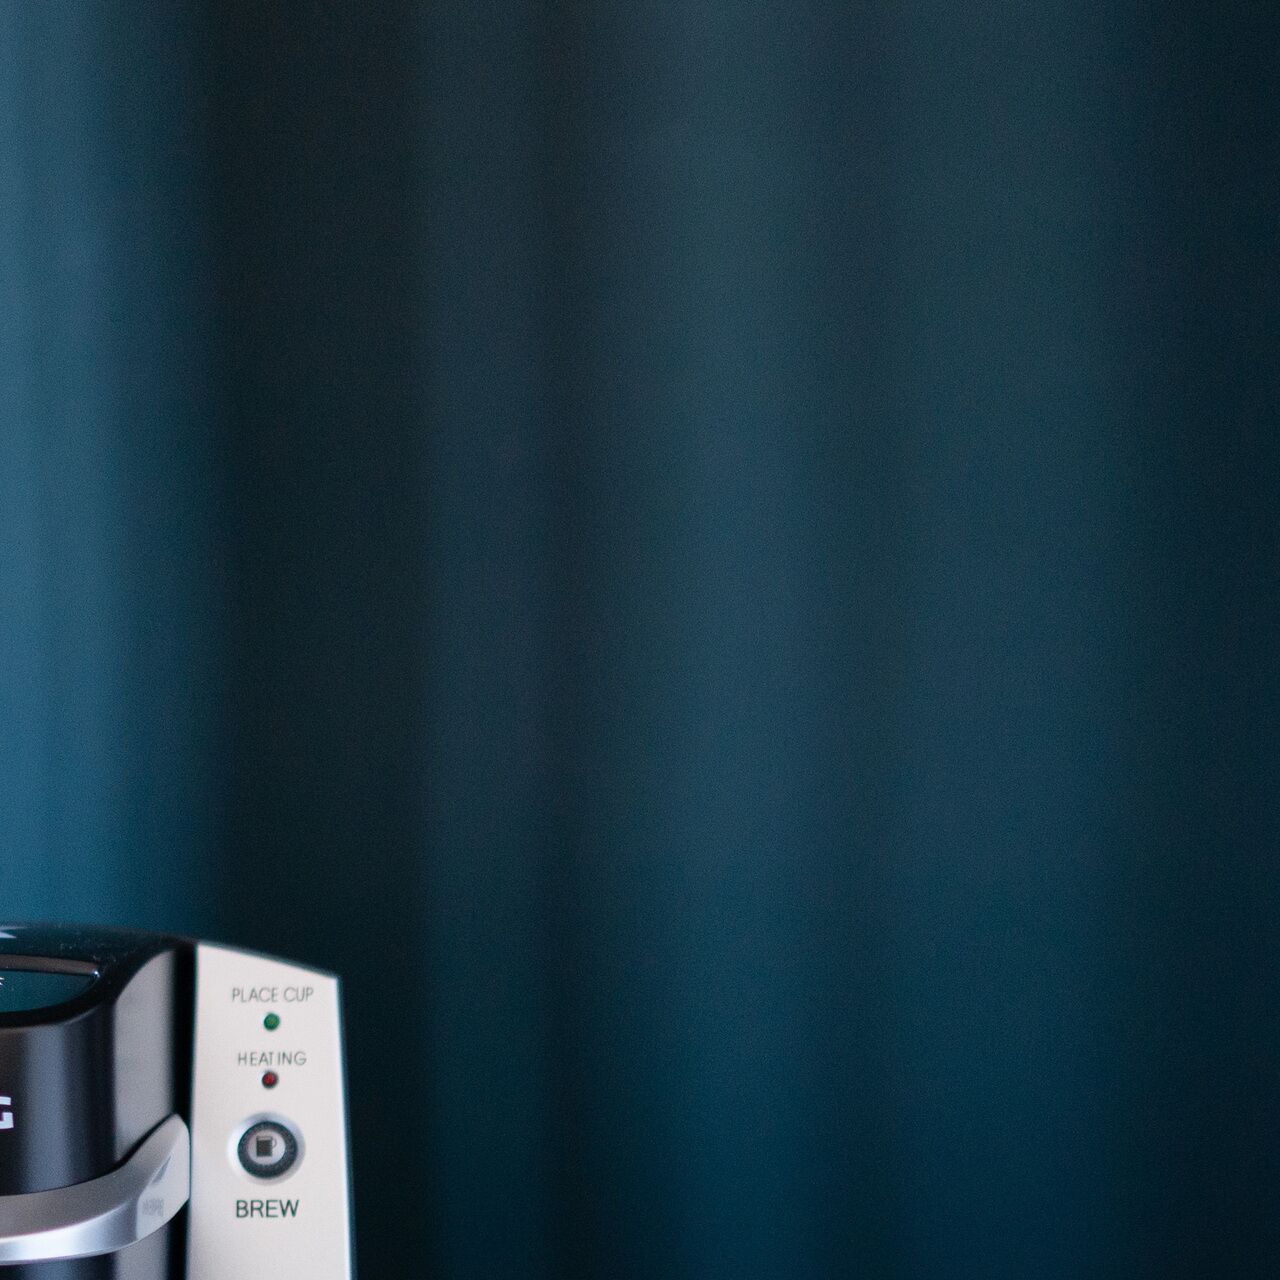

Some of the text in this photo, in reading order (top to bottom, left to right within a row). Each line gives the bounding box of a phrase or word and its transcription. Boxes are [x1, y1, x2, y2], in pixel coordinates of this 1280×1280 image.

[232, 987, 314, 1002] PLACE CUP
[237, 1051, 307, 1066] HEATING
[235, 1199, 300, 1219] BREW
